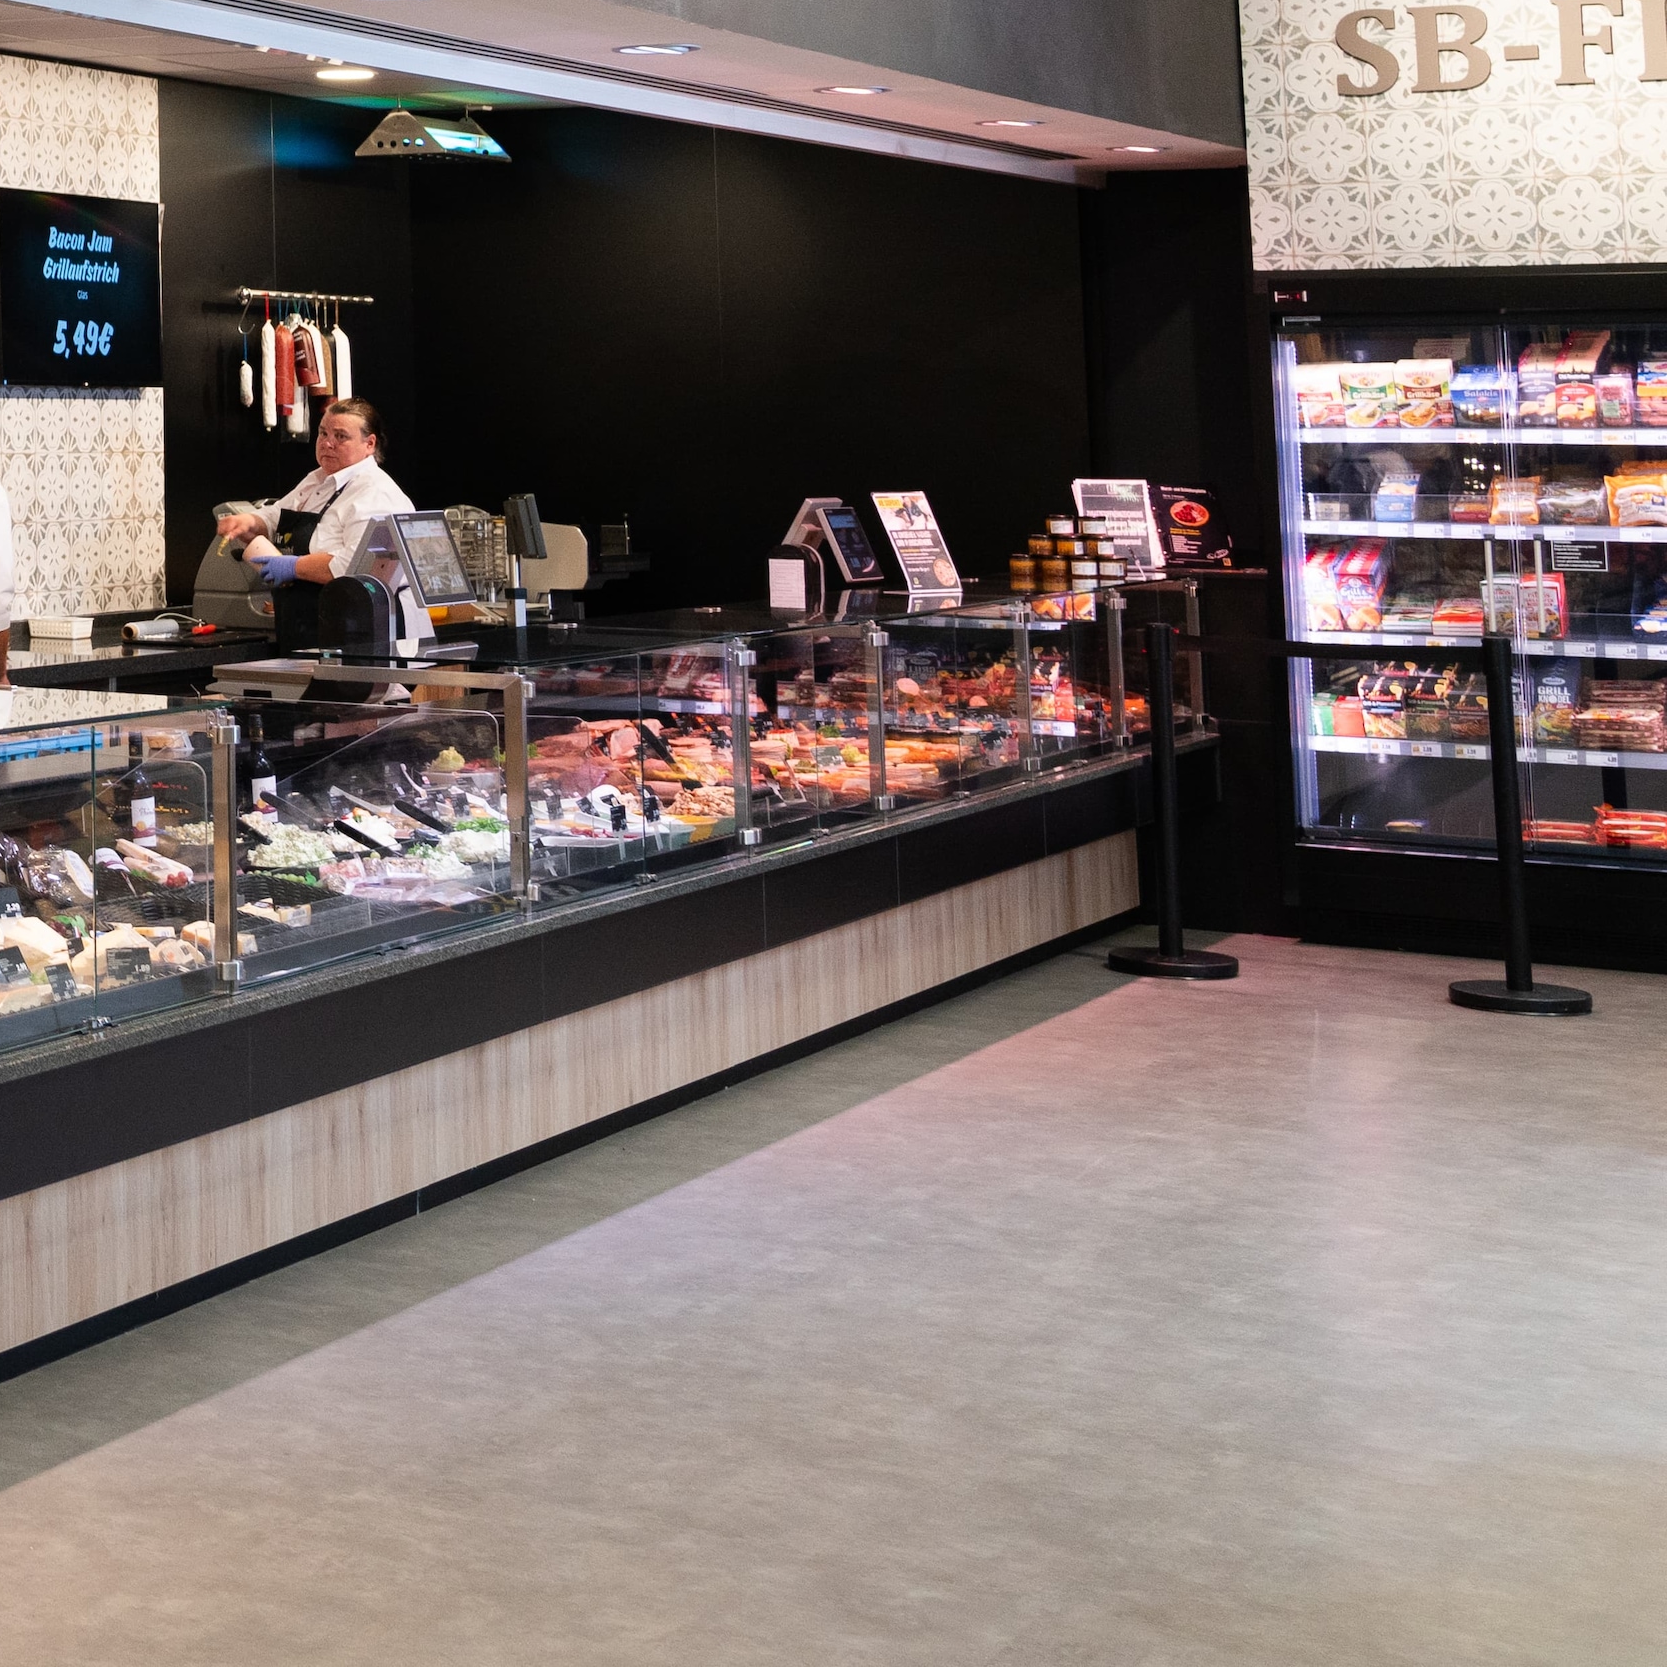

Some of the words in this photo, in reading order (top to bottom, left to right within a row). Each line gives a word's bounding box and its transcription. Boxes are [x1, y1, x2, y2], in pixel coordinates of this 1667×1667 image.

[48, 226, 85, 251] Bacon
[87, 230, 113, 253] Jam
[42, 256, 120, 284] Grillaufstrich
[77, 290, 88, 300] Glas
[53, 319, 114, 359] 5,49€
[1537, 686, 1571, 696] GRILL
